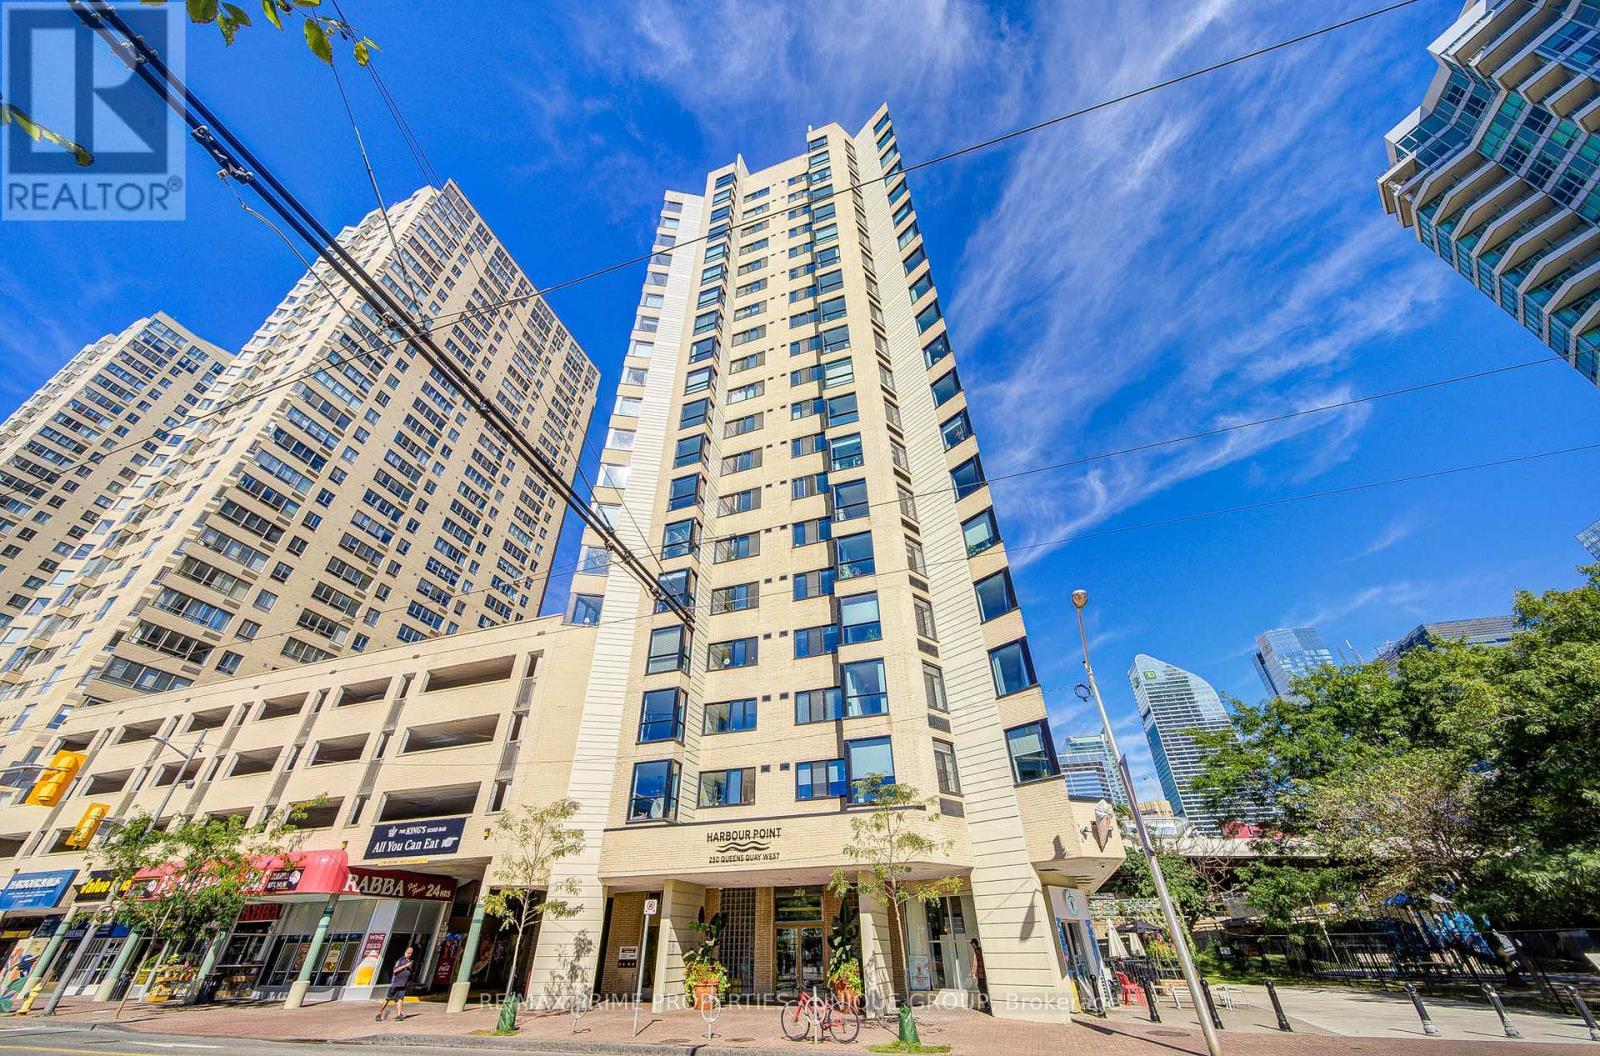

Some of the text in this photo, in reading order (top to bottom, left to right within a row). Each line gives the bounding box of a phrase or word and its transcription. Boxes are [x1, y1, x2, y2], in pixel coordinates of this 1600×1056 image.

[707, 827, 782, 843] HARBOUR POINT
[372, 838, 439, 853] All You Can Eat
[708, 852, 780, 864] 250 QUEENS QUAY WEST
[80, 877, 111, 894] Value
[342, 873, 405, 897] RABBA
[425, 884, 441, 898] 24
